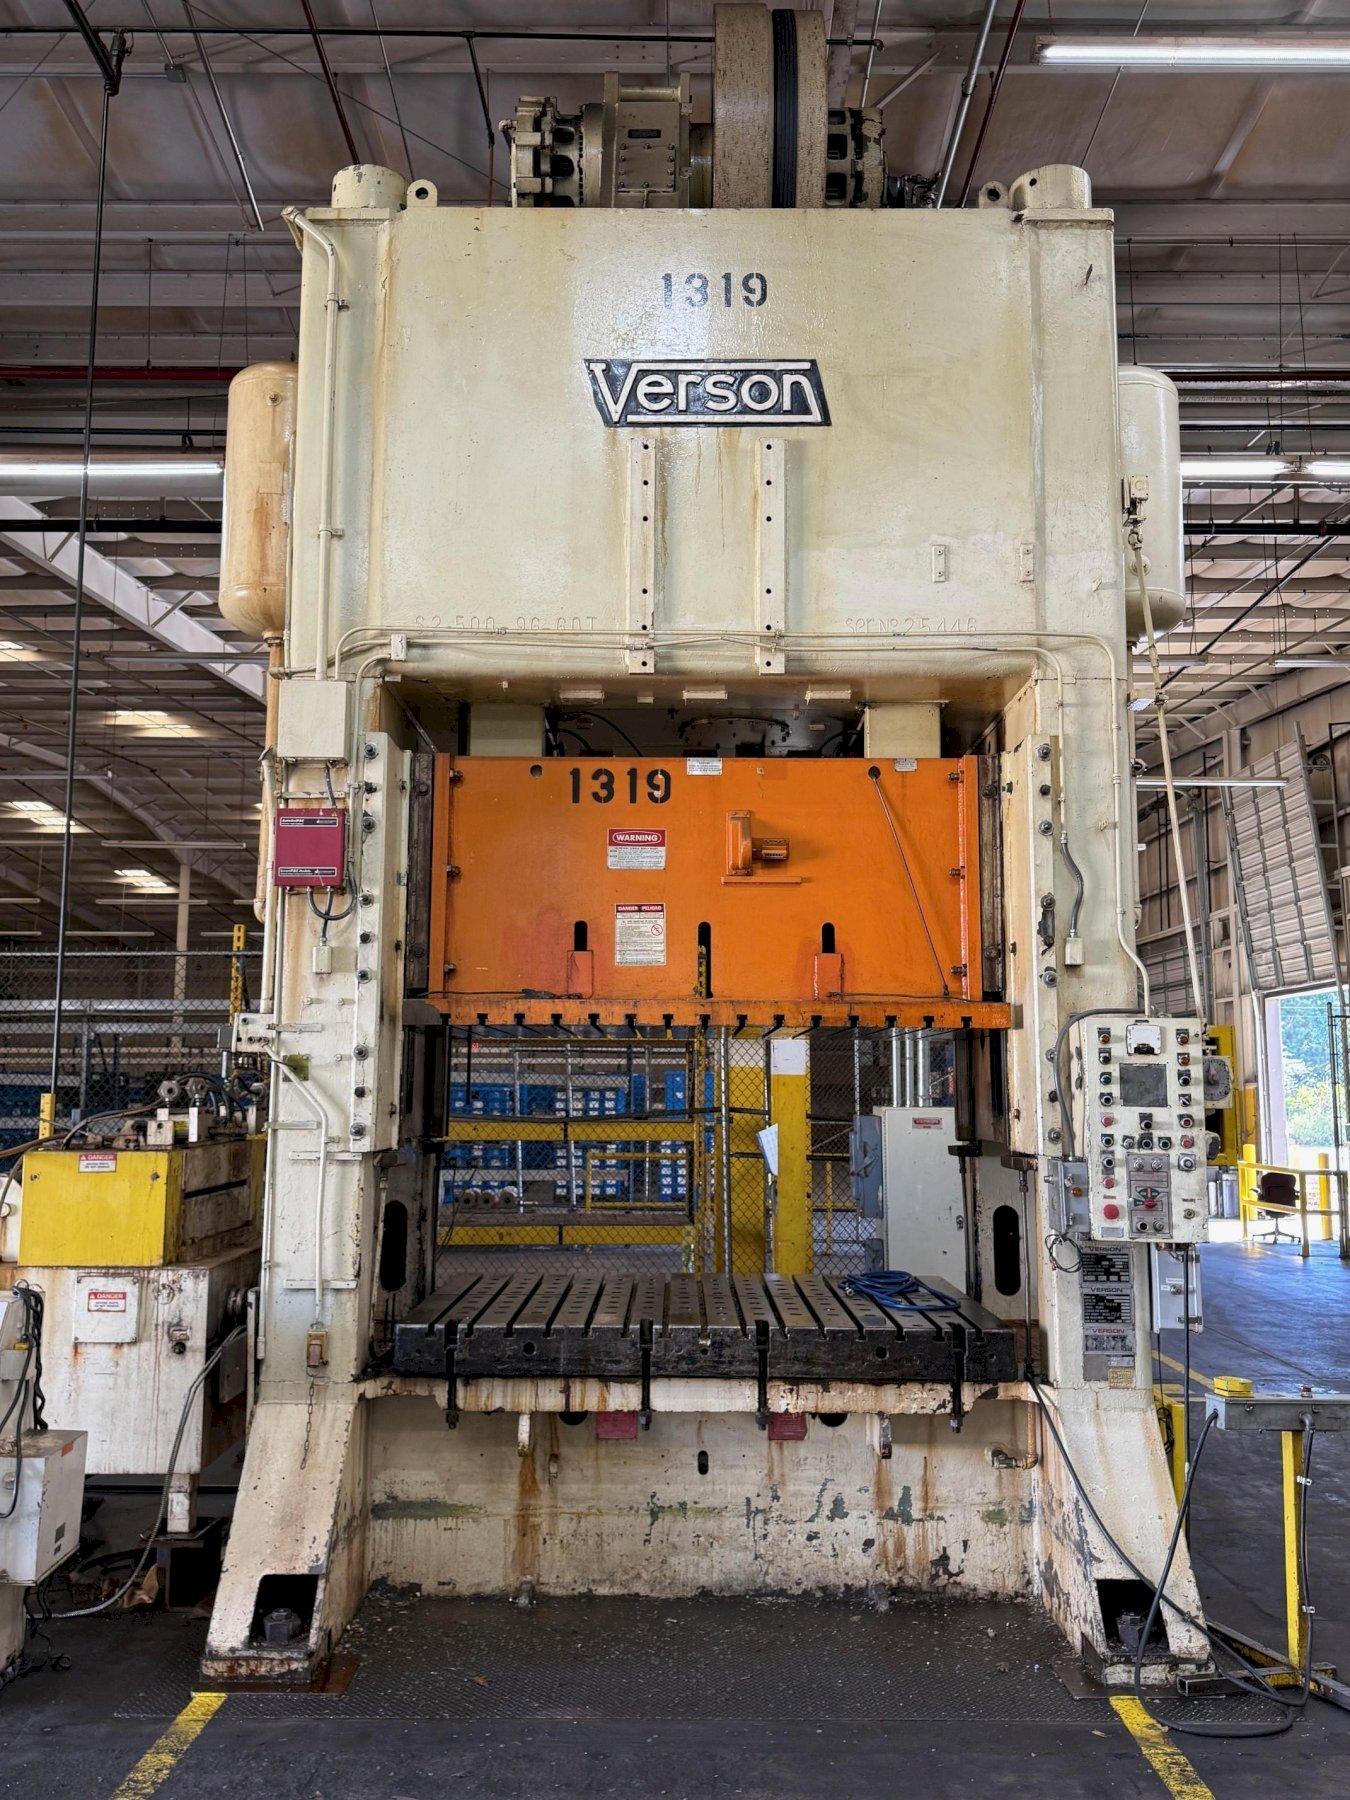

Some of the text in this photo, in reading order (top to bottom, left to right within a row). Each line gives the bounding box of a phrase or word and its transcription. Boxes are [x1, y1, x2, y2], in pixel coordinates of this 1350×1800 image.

[661, 272, 768, 308] 1319
[589, 362, 822, 424] Verson
[569, 767, 672, 804] 1319
[615, 834, 658, 842] WARNING
